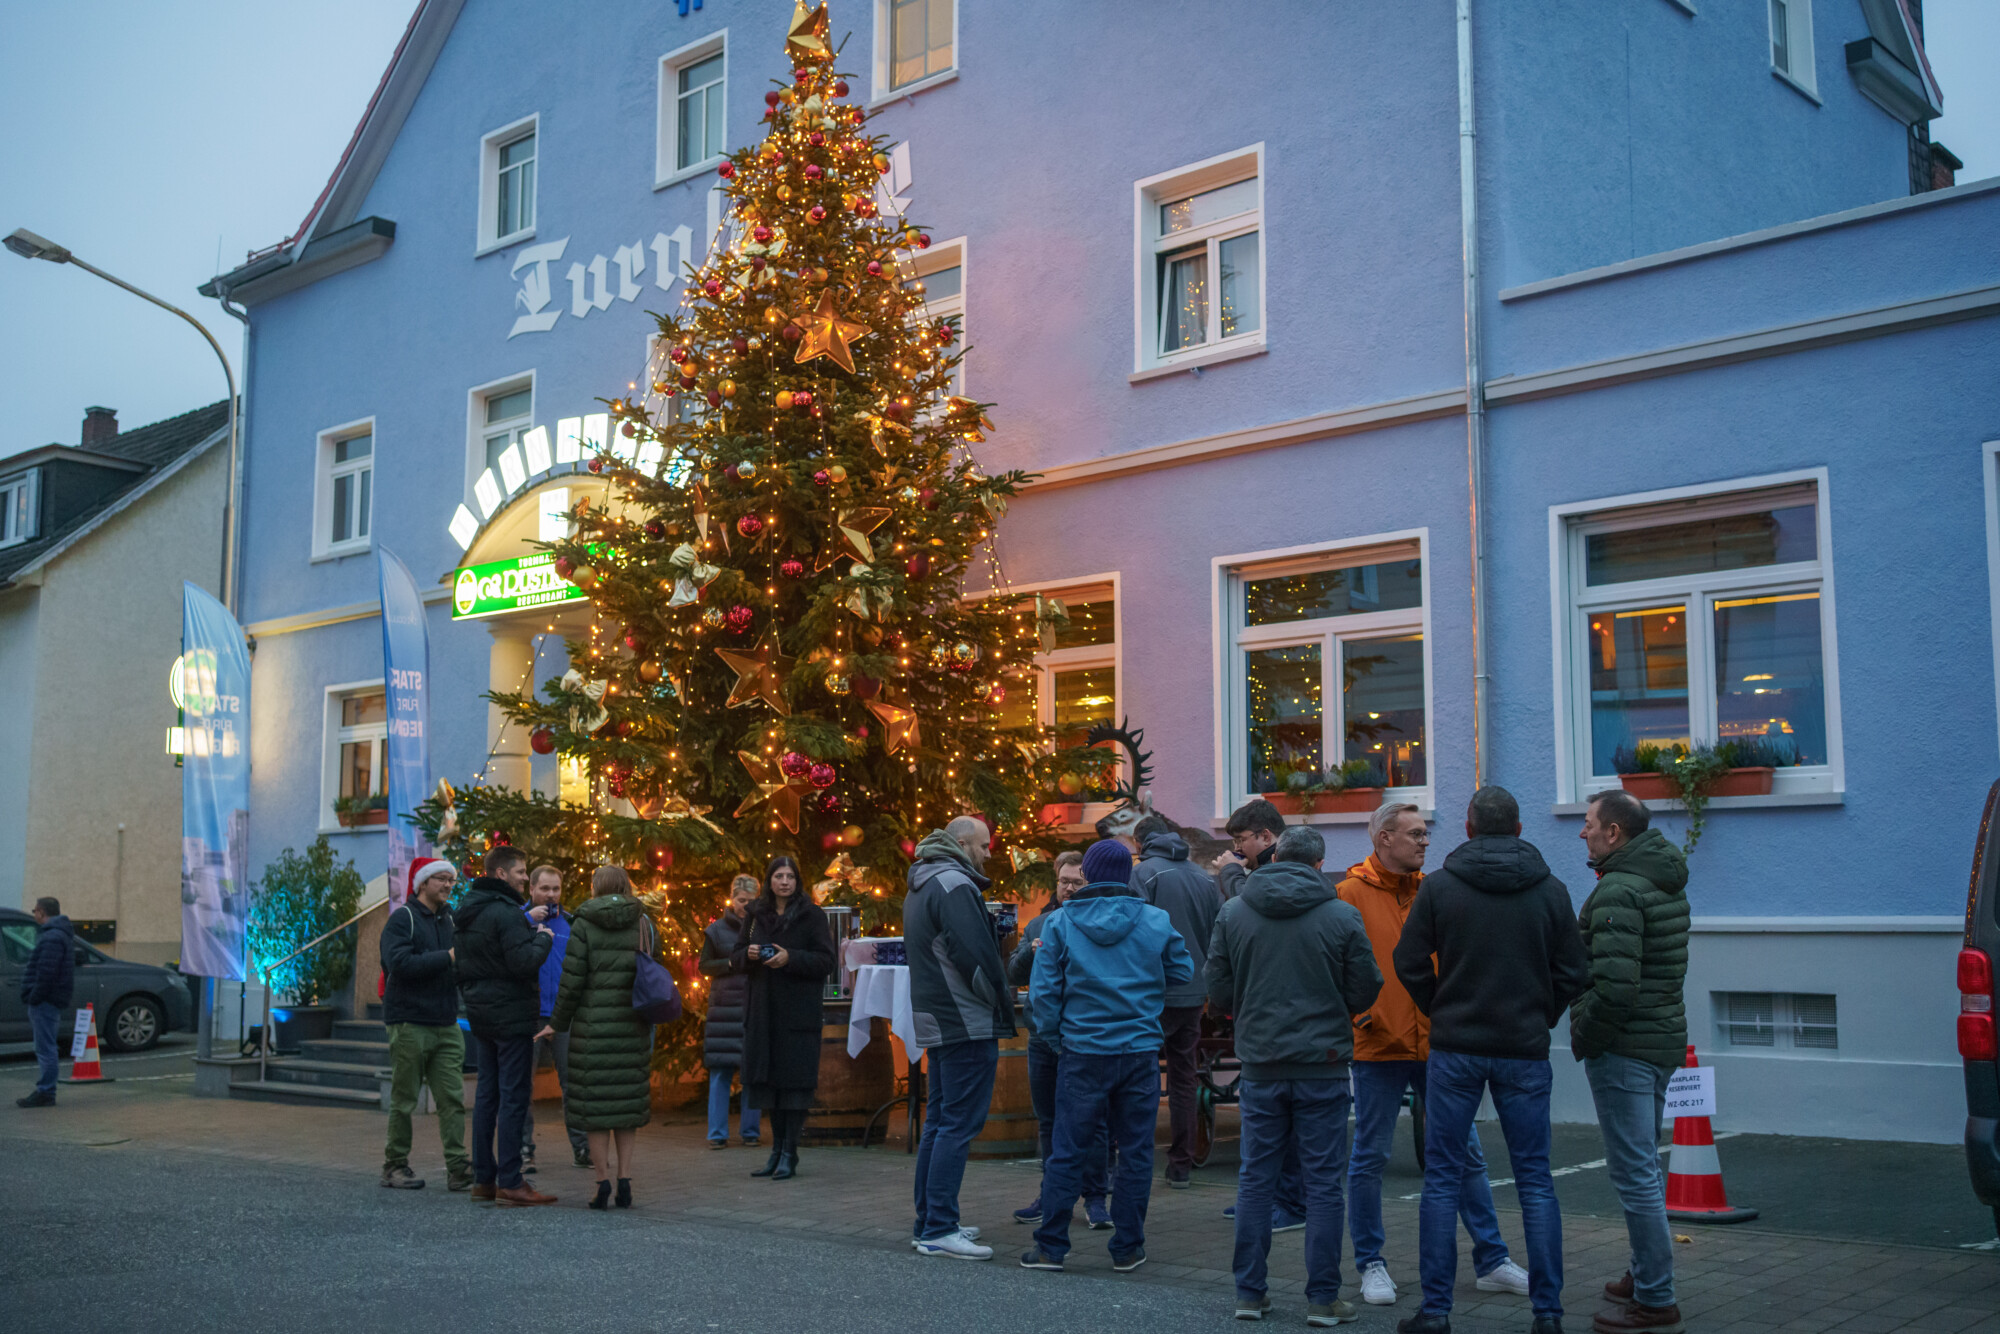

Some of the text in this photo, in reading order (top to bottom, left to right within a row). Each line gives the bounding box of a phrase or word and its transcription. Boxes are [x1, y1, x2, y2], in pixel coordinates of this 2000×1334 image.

[516, 589, 568, 607] RESTAURANT
[1668, 1085, 1701, 1093] RESERVIERT
[1667, 1100, 1690, 1108] WZ-OC
